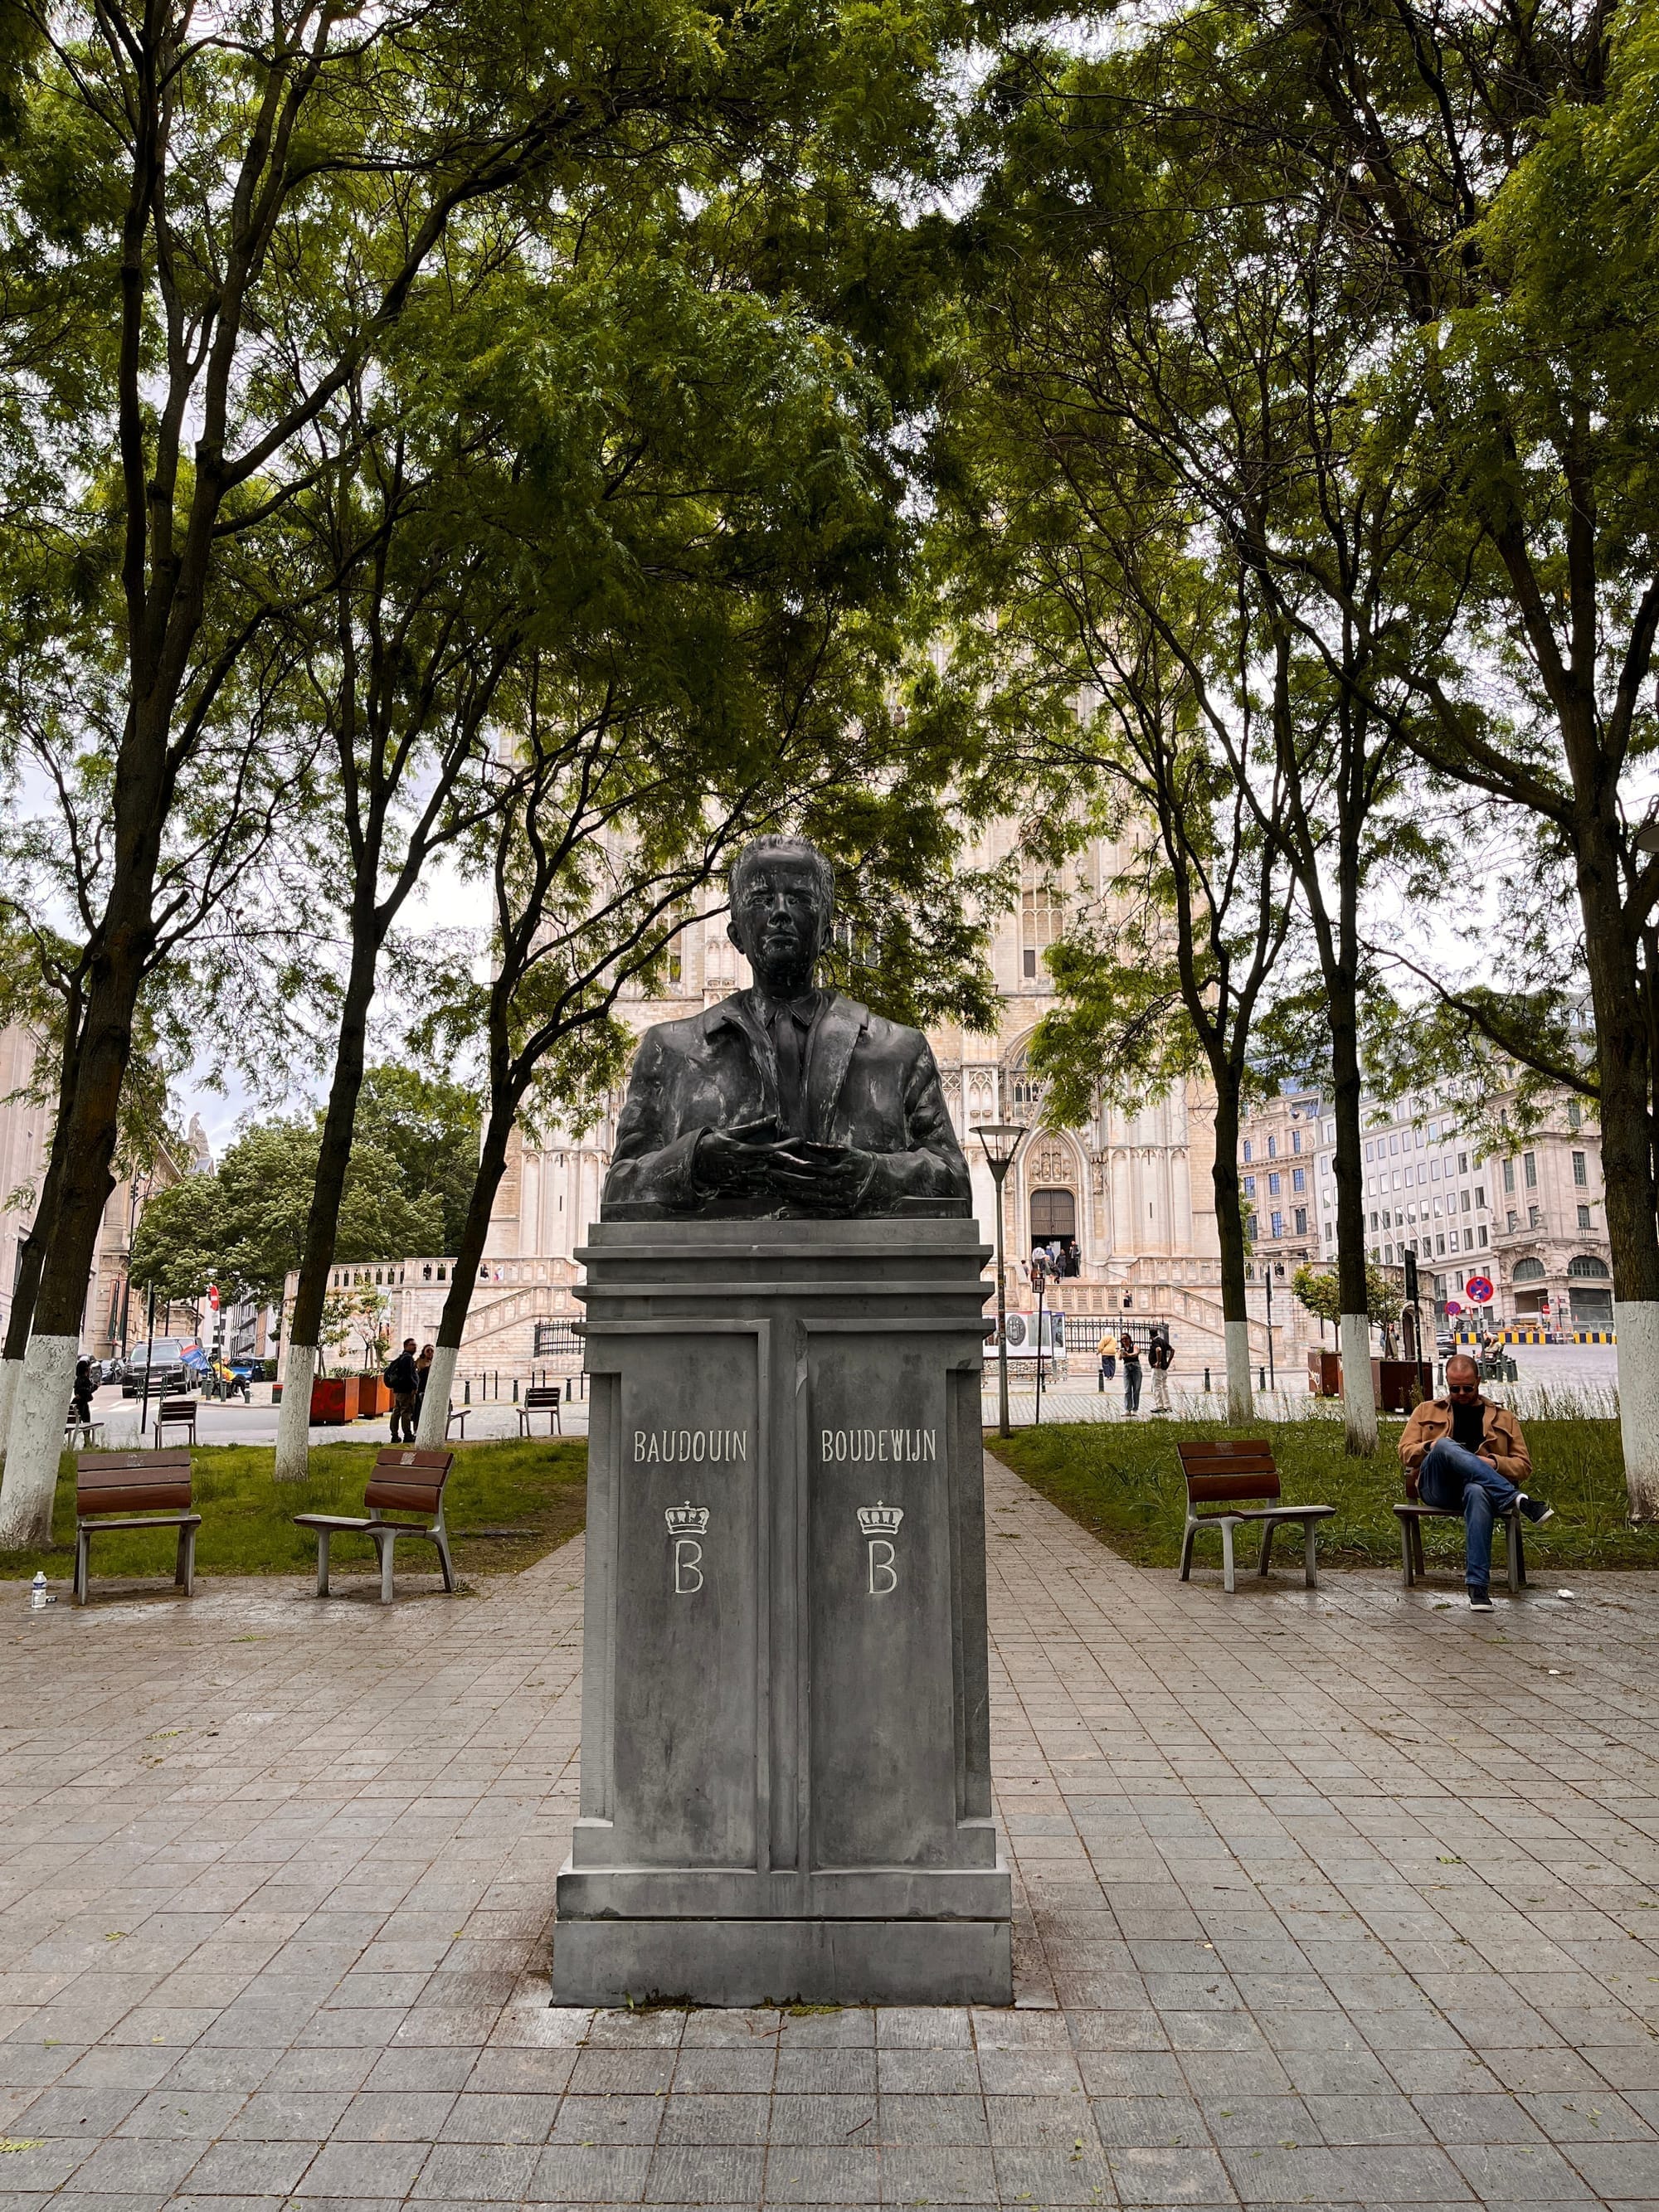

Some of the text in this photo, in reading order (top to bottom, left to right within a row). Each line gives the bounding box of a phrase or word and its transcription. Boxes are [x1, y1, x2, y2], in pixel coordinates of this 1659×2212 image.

[634, 1430, 747, 1462] BAUDOUIN
[821, 1428, 937, 1462] BOUDEWIJN
[674, 1540, 704, 1594] B
[868, 1539, 898, 1594] B
